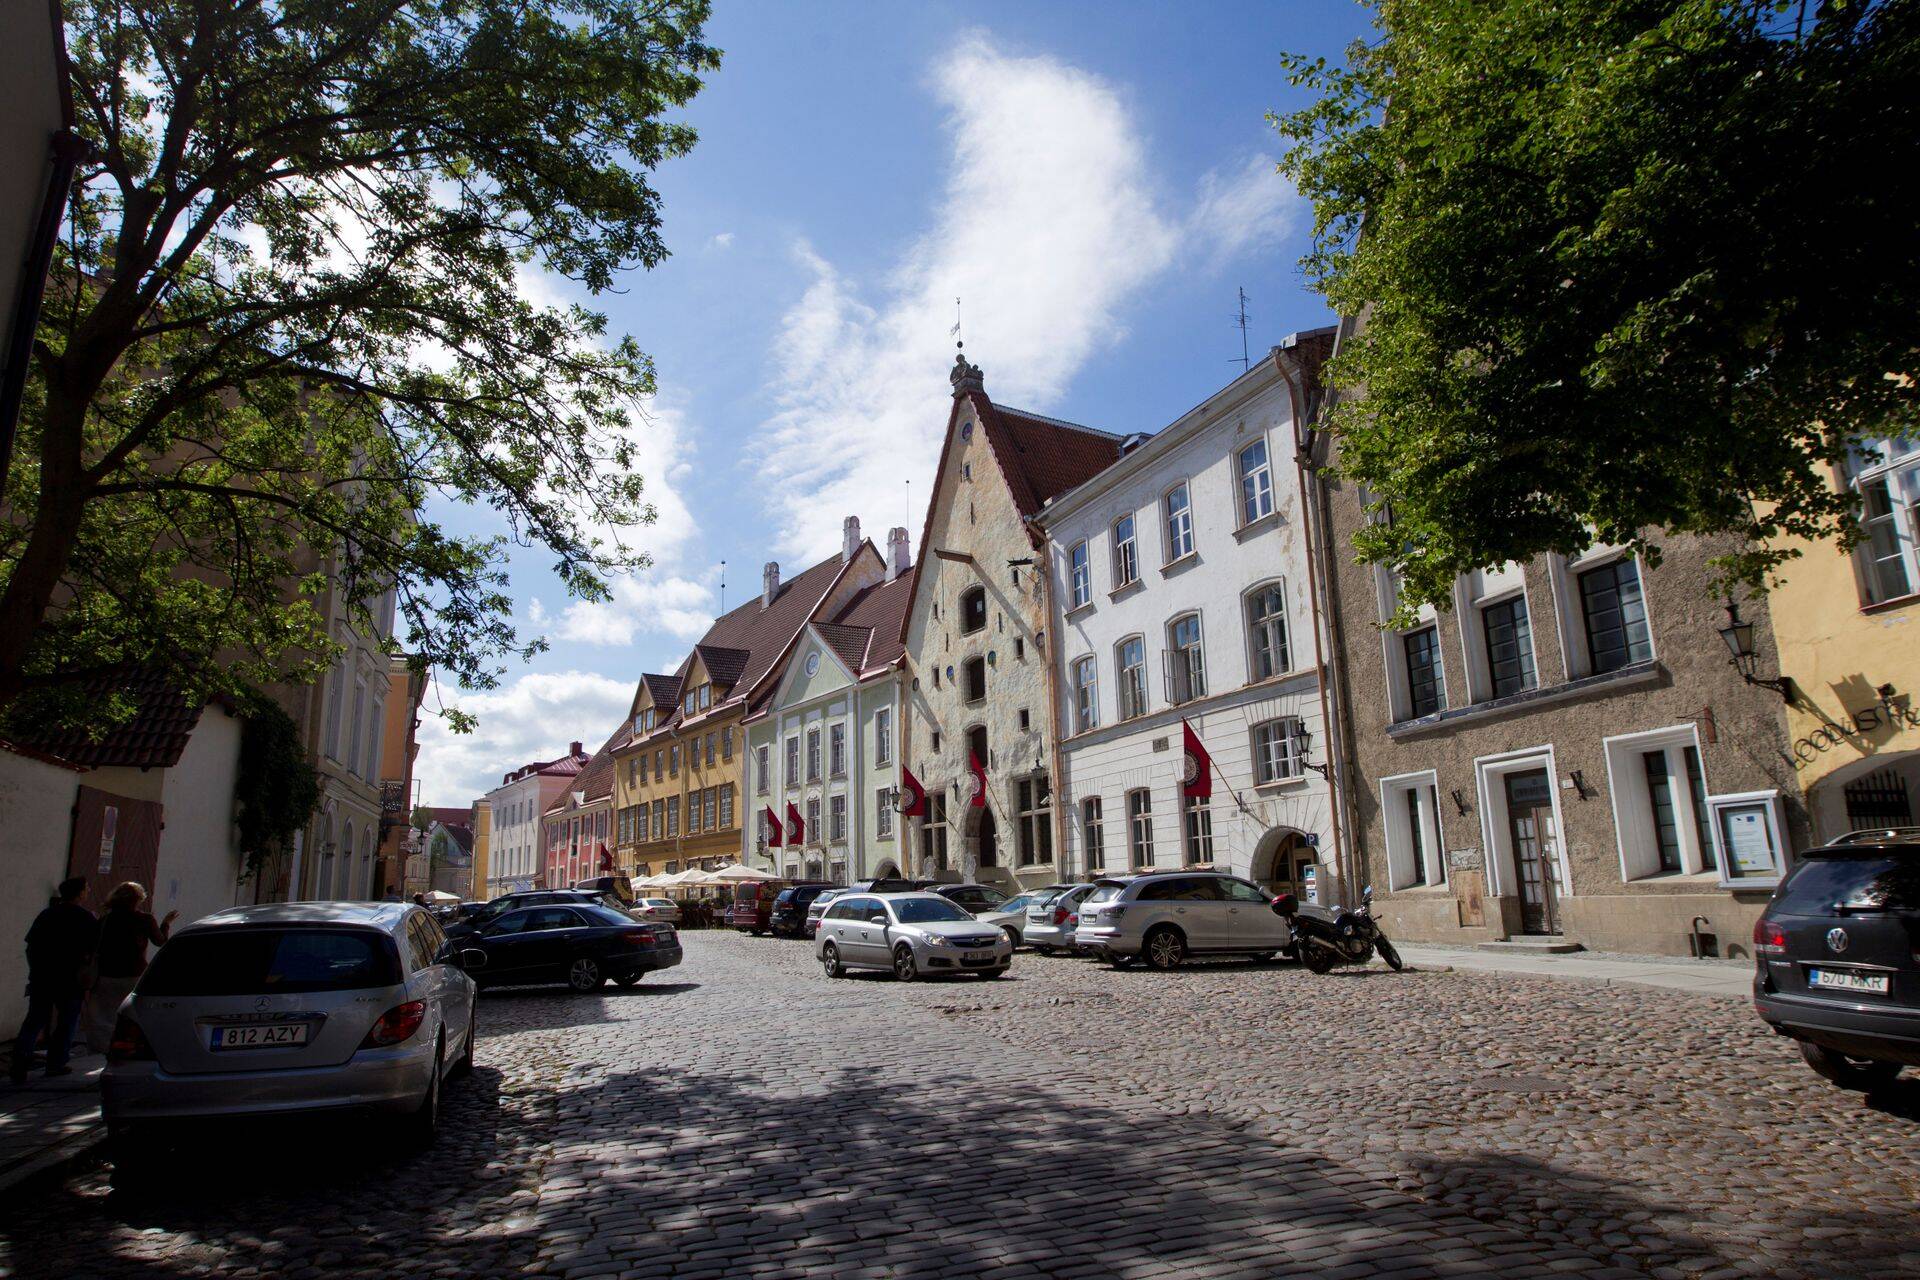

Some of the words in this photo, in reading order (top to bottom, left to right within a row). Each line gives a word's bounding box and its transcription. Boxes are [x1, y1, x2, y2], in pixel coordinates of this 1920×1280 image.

[1308, 834, 1315, 844] P
[228, 1029, 257, 1045] 812
[264, 1026, 300, 1043] AZY
